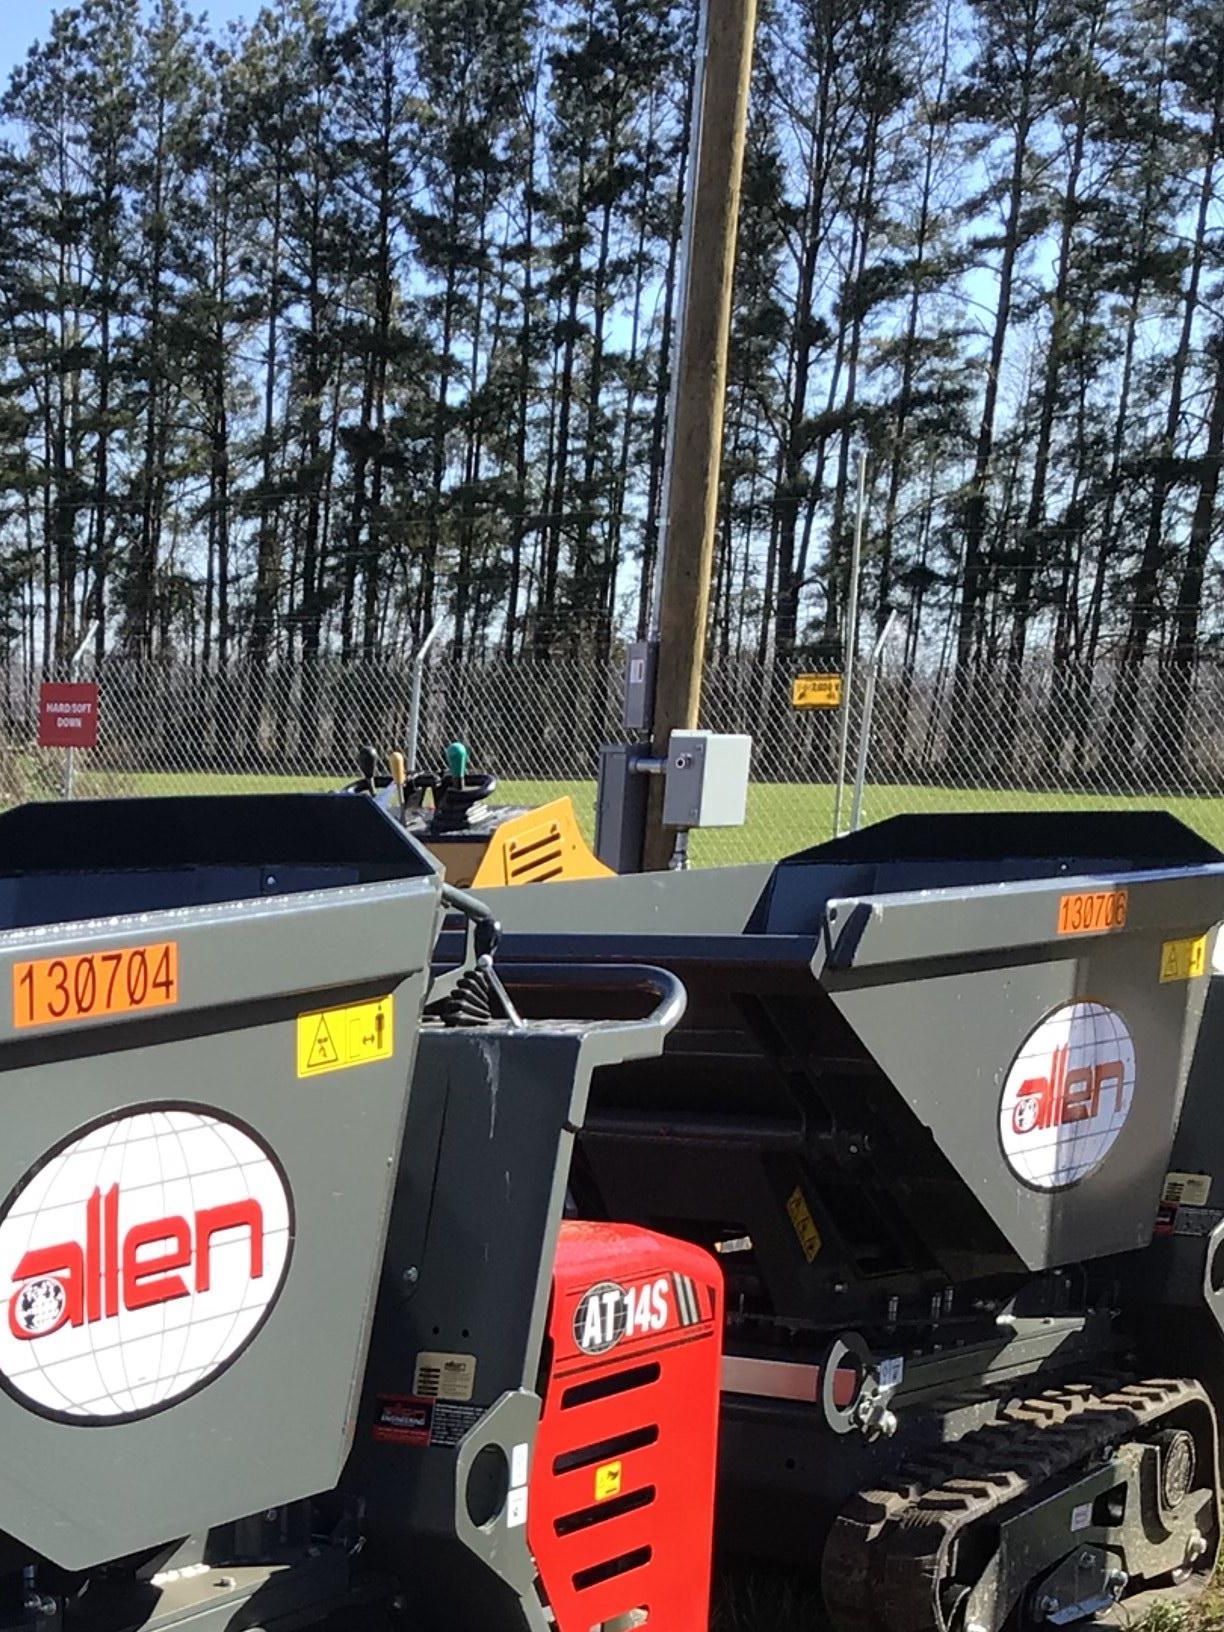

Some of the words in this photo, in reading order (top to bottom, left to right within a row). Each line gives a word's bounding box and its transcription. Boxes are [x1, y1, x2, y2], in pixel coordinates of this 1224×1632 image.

[1063, 893, 1125, 930] 130706
[20, 945, 174, 1021] 130704
[1012, 1043, 1124, 1134] allen
[8, 1183, 263, 1340] allen
